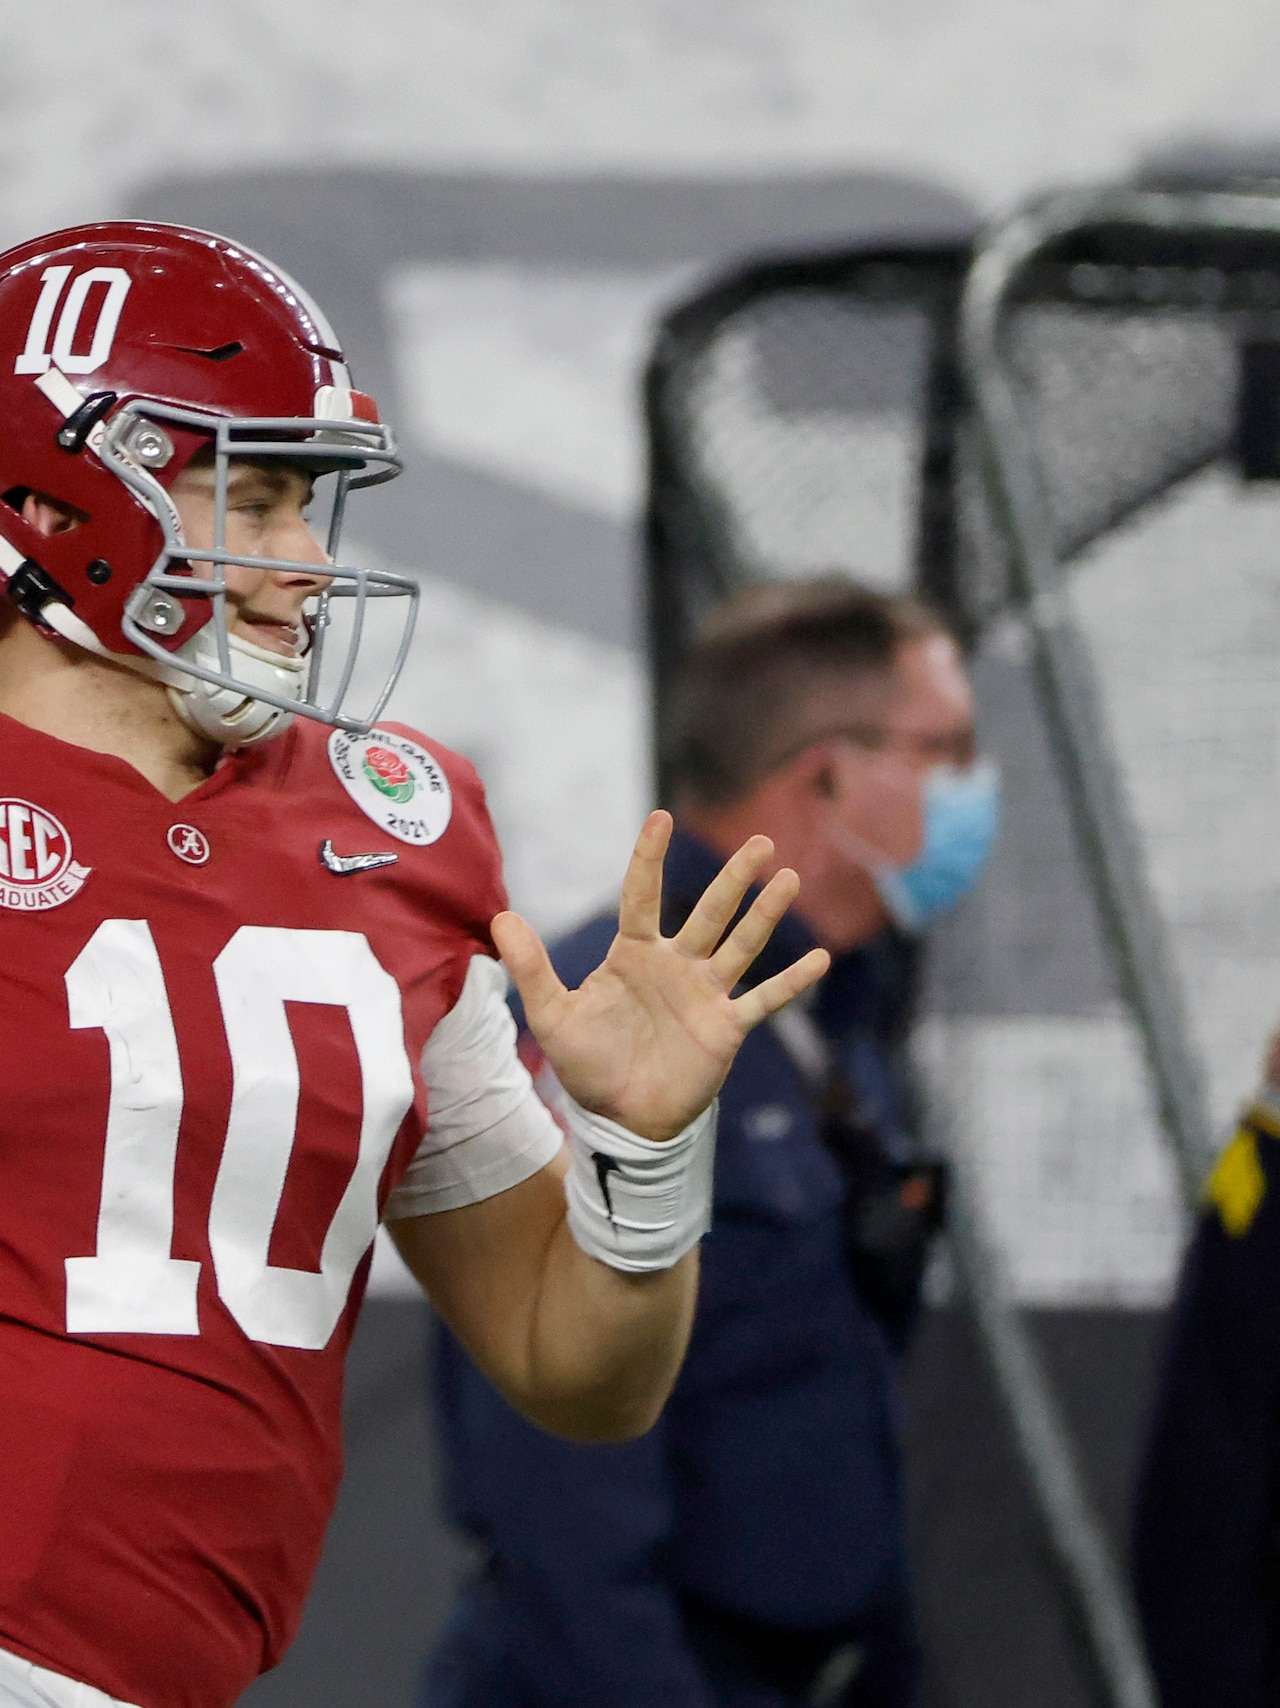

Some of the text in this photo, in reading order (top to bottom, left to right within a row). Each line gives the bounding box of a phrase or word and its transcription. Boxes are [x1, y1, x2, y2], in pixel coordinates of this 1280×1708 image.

[14, 265, 133, 375] 10
[401, 743, 444, 794] GAME
[386, 812, 431, 839] 2021
[64, 918, 415, 1351] 10
